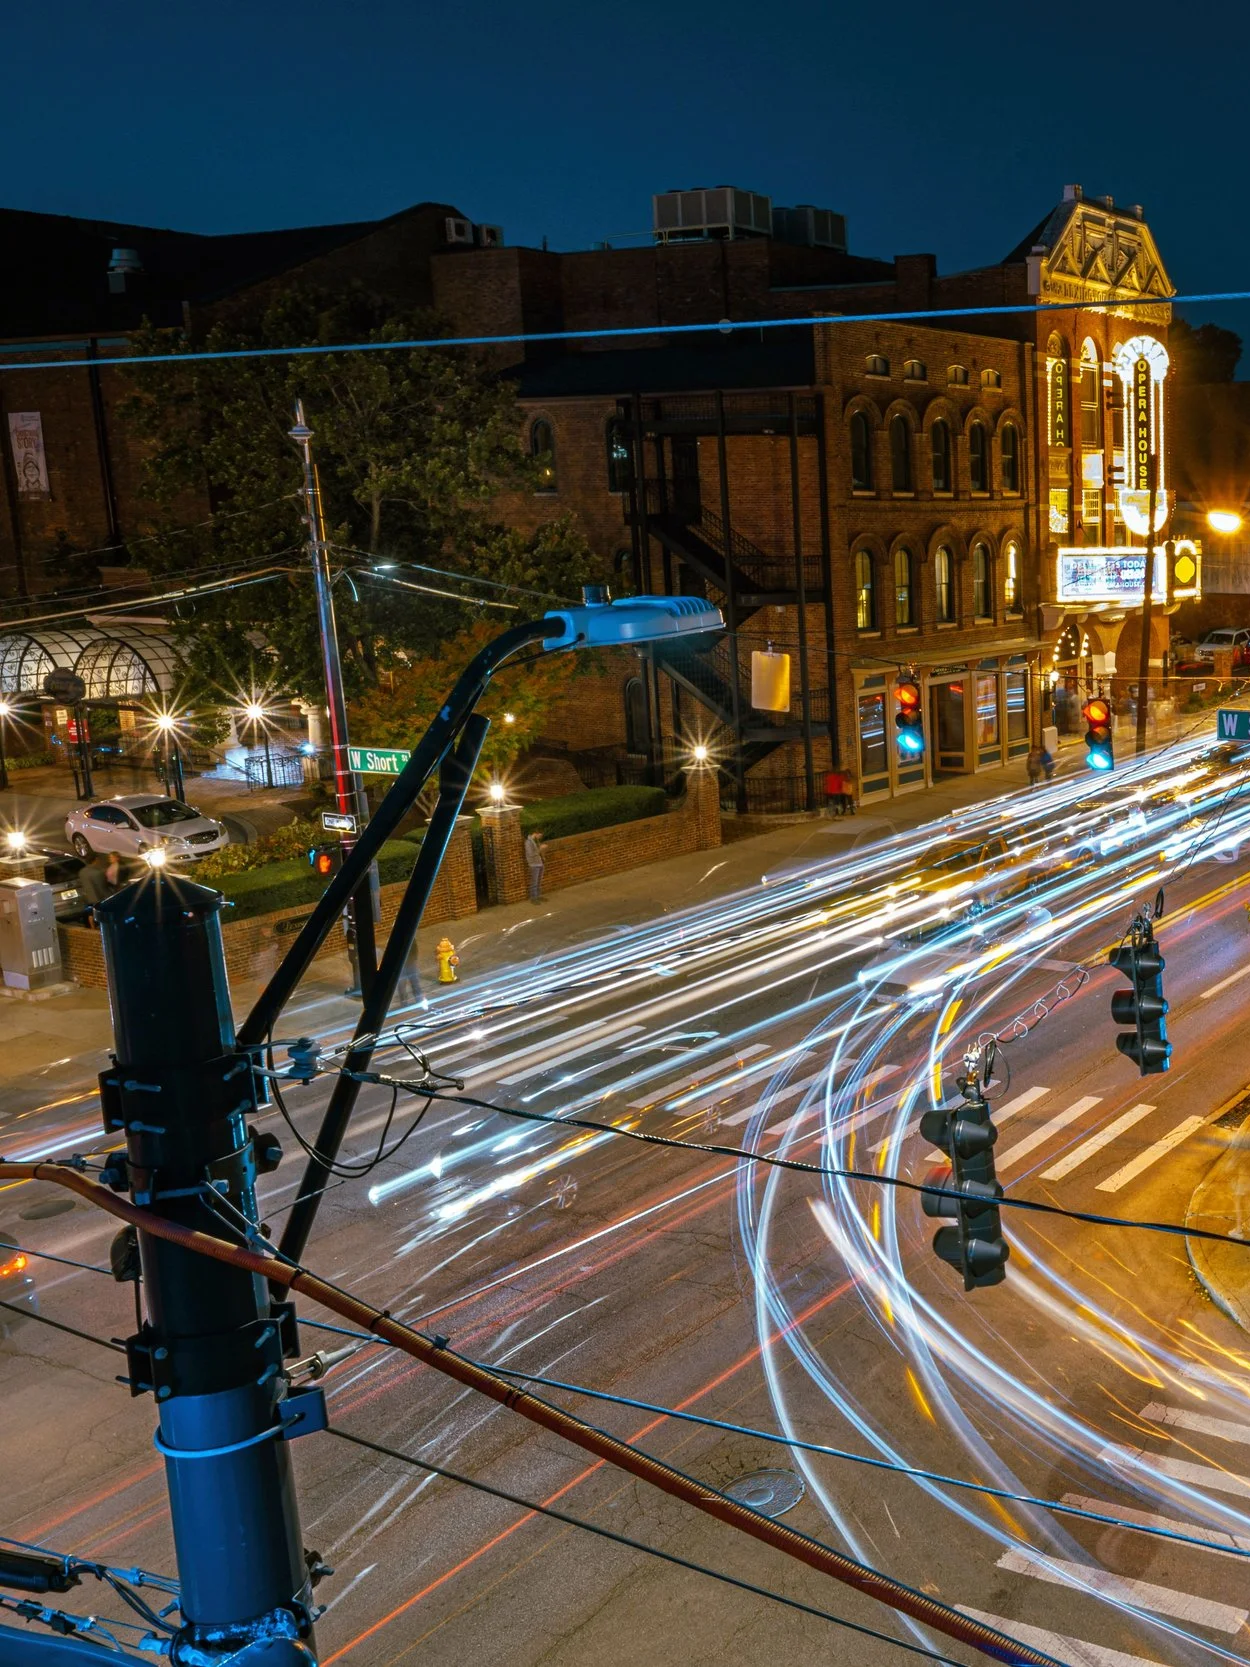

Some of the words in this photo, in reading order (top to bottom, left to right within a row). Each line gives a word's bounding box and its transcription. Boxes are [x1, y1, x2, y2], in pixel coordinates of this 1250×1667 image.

[1137, 360, 1148, 422] OPERA
[1138, 427, 1148, 490] HOUSE
[1222, 713, 1238, 736] W
[350, 751, 361, 769] W
[366, 752, 399, 772] Short
